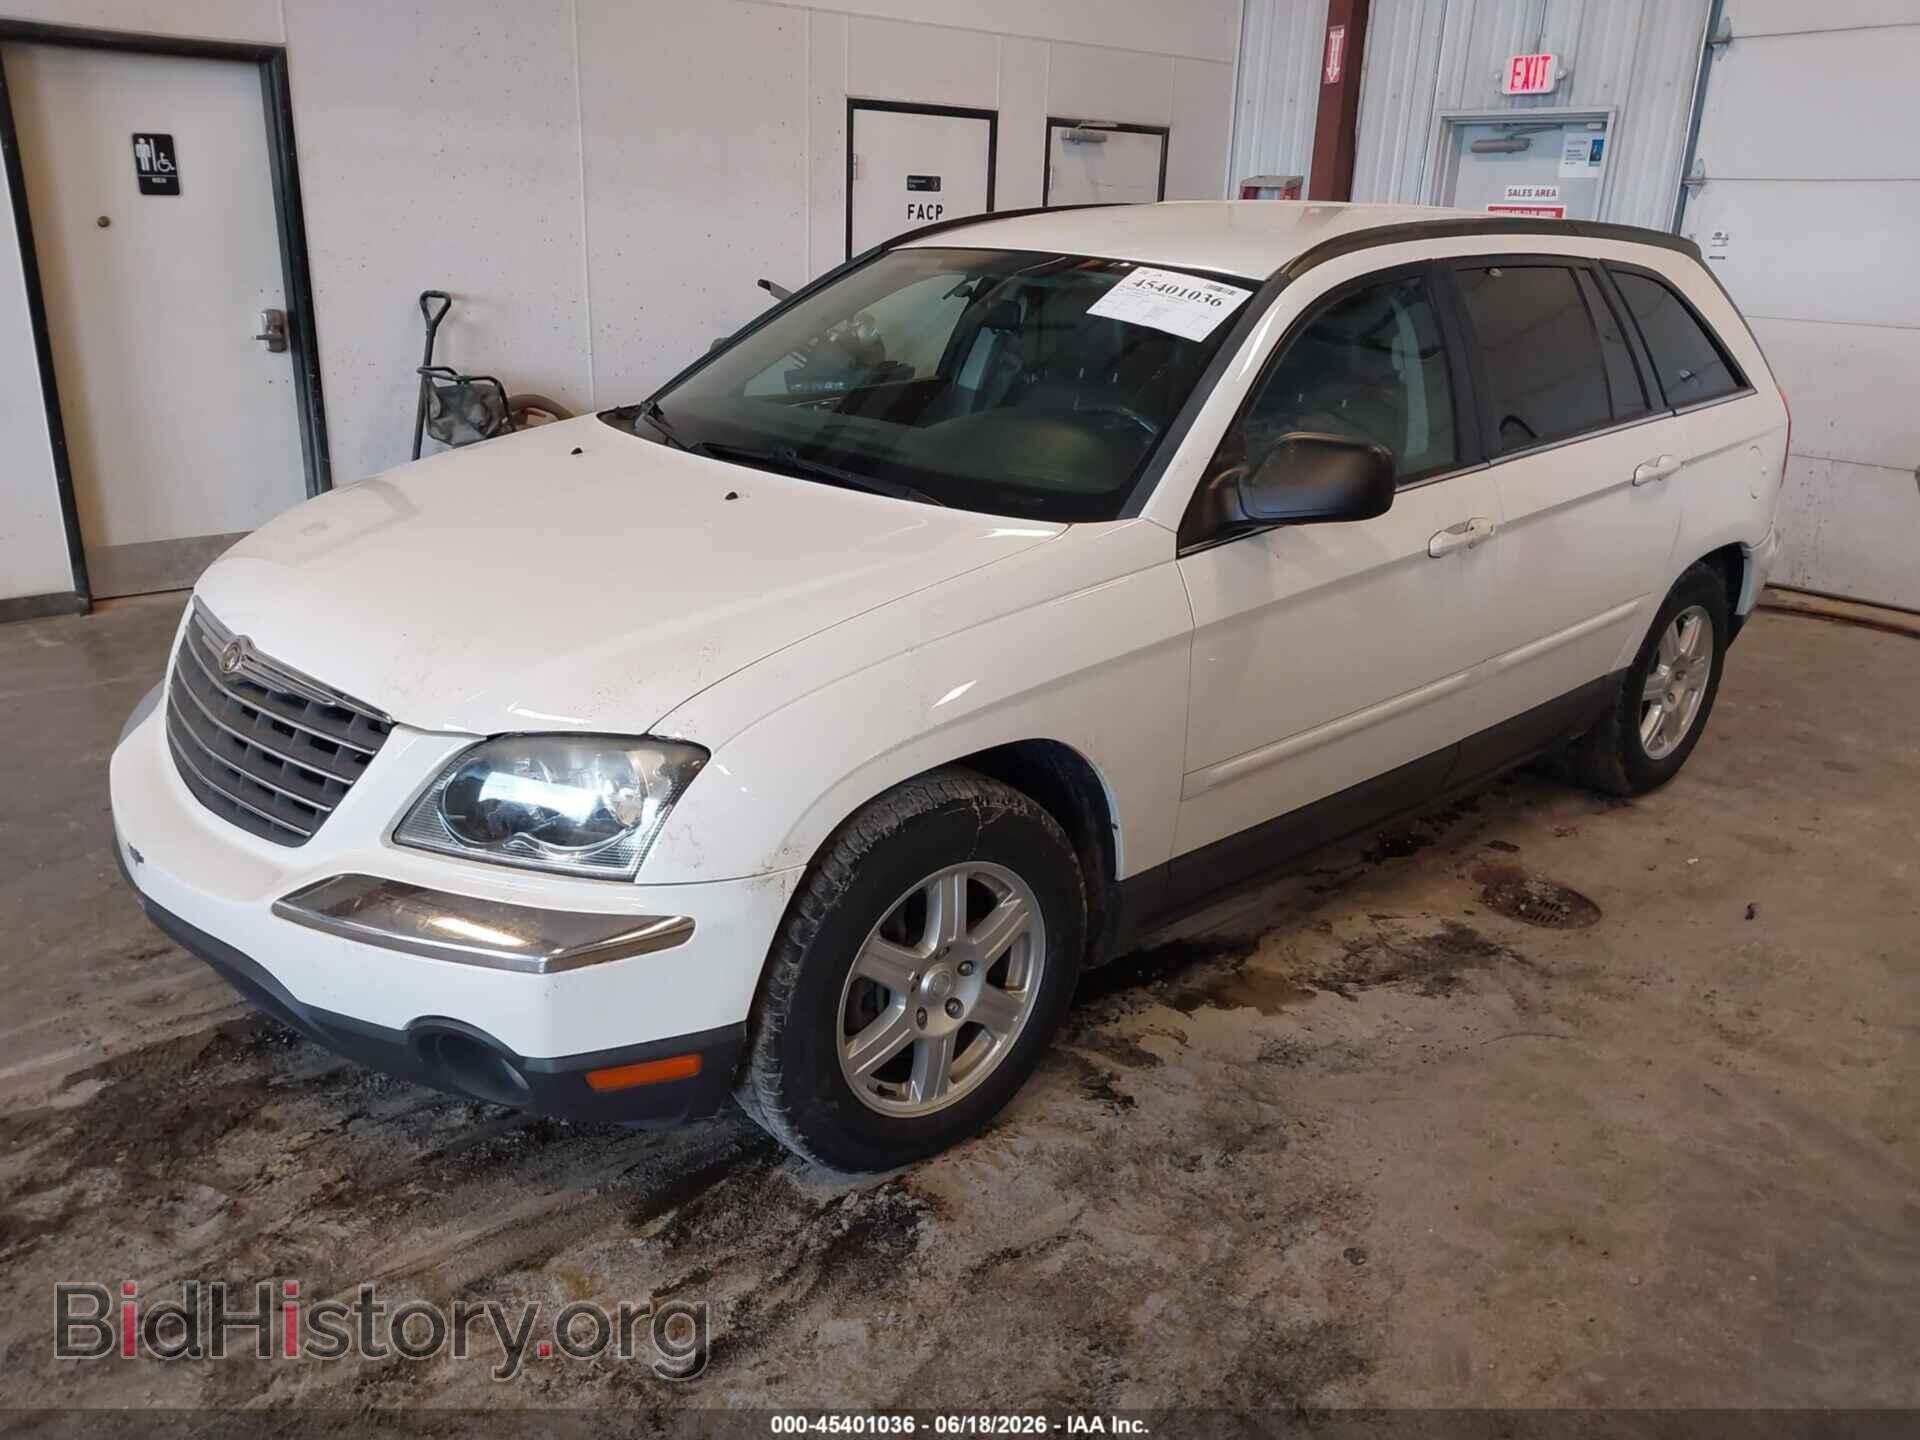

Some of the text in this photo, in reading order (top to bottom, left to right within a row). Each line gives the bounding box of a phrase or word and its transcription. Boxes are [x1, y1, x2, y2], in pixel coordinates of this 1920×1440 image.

[1510, 56, 1551, 91] EXIT
[1508, 188, 1557, 197] SALES AREA
[907, 203, 943, 220] FACP
[1132, 278, 1223, 309] 45401036
